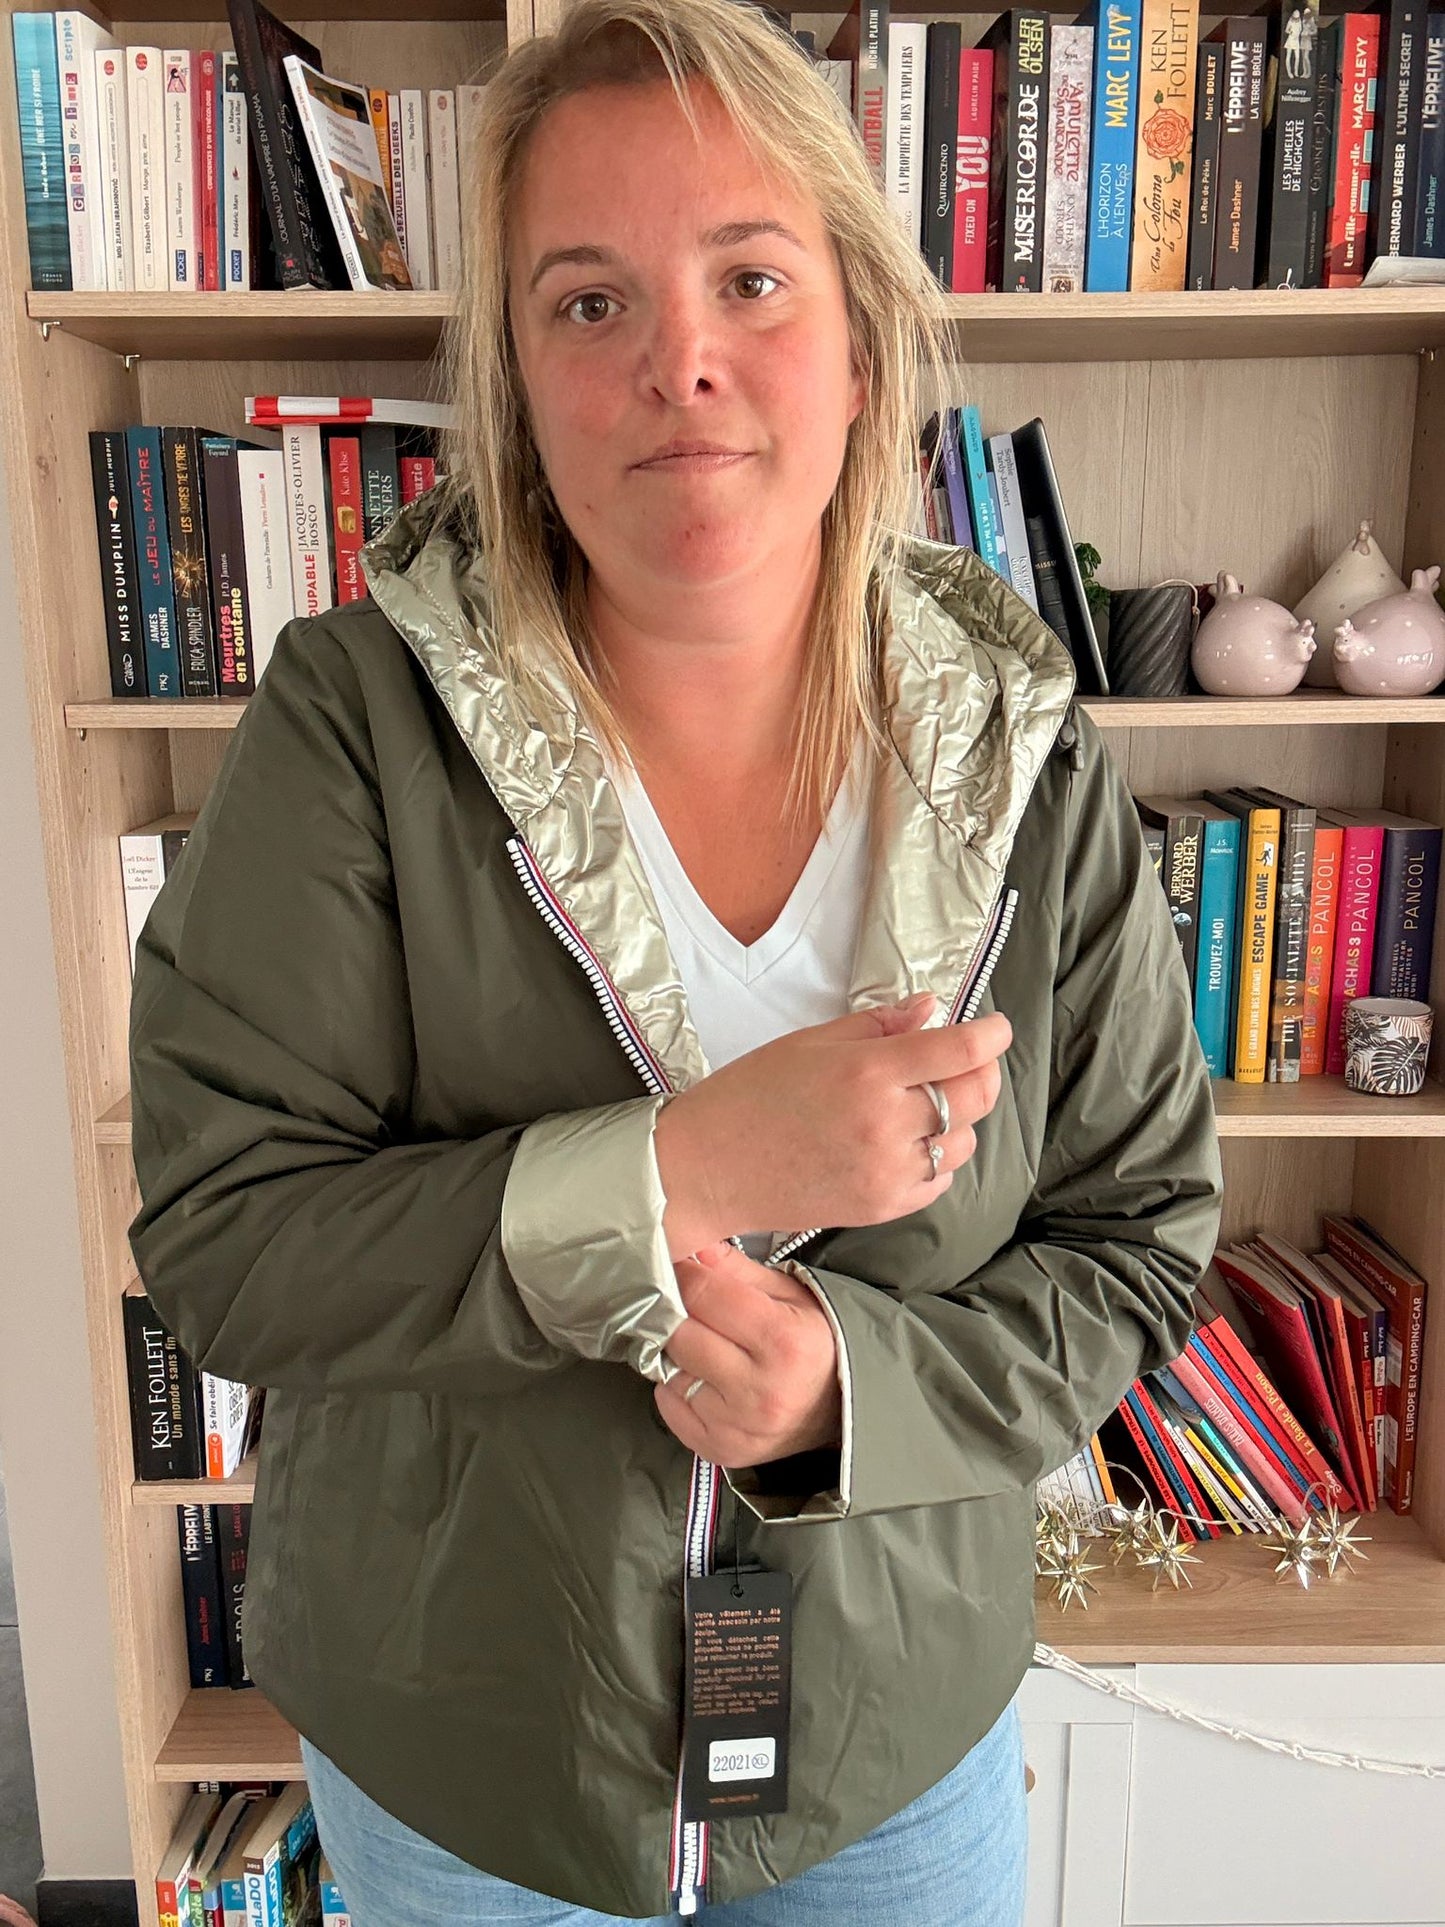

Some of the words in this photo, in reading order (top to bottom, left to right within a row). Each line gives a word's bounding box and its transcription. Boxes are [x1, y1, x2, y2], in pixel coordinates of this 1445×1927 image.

[869, 9, 879, 38] PLATINI
[1107, 9, 1132, 61] LEVY
[869, 40, 878, 69] MICHEL
[1018, 18, 1030, 66] ADLER
[1030, 19, 1044, 74] OLSEN
[1151, 29, 1167, 72] KEN
[1167, 2, 1190, 98] FOLLETT
[1250, 42, 1262, 76] BRÛLÉE
[1355, 36, 1368, 78] LEVY
[1400, 33, 1412, 76] SECRET
[901, 46, 913, 100] TEMPLIERS
[1206, 55, 1216, 94] BOULET
[1224, 41, 1248, 133] L'ÉPREUVE
[33, 99, 43, 107] SI
[971, 86, 979, 120] LAURELIN
[1105, 71, 1129, 127] MARC
[1205, 97, 1214, 120] Marc
[1251, 79, 1261, 105] TERRE
[1352, 83, 1365, 128] MARC
[1396, 79, 1409, 135] L'ULTIME
[252, 93, 265, 128] PYJAMA
[901, 104, 911, 120] DES
[1250, 107, 1260, 119] LA
[36, 128, 46, 143] UNE
[260, 130, 268, 142] EN
[392, 122, 400, 155] GEEKS
[897, 125, 910, 178] PROPHÉTIE
[1282, 120, 1294, 170] JUMELLES
[1293, 120, 1304, 174] HIGHGATE
[262, 144, 277, 179] VAMPIRE
[956, 135, 989, 193] YOU
[1202, 159, 1211, 183] Pékin
[1350, 143, 1361, 166] elle
[1393, 143, 1405, 197] WERBER
[271, 181, 280, 201] D'UN
[899, 183, 910, 193] LA
[937, 144, 950, 217] QUATTROCENTO
[1202, 186, 1209, 195] de
[1282, 174, 1292, 190] LES
[1292, 179, 1301, 191] DE
[1349, 169, 1359, 213] comme
[1425, 174, 1437, 214] Dashner
[395, 182, 404, 232] SEXUELLE
[966, 200, 976, 213] ON
[1098, 163, 1112, 238] L'HORIZON
[1143, 175, 1162, 242] Colonne
[1201, 198, 1209, 210] Roi
[1230, 179, 1242, 219] Dashner
[276, 204, 289, 244] JOURNAL
[965, 216, 976, 244] FIXED
[1055, 200, 1065, 245] STROUD
[1065, 194, 1076, 251] JONATHAN
[1113, 228, 1125, 238] À
[1163, 199, 1182, 239] Feu
[1201, 213, 1208, 223] Le
[1344, 216, 1357, 241] fille
[1389, 200, 1402, 256] BERNARD
[1423, 217, 1435, 247] James
[1230, 222, 1241, 252] James
[1344, 244, 1355, 266] Une
[105, 438, 113, 469] MURPHY
[174, 443, 187, 471] VERRE
[1005, 448, 1015, 476] Sophie
[107, 472, 115, 492] JULIE
[138, 448, 154, 512] MAÎTRE
[290, 436, 308, 547] JACQUES-OLIVIER
[340, 475, 351, 495] Kate
[368, 470, 382, 535] NNETTE
[148, 516, 156, 532] DU
[181, 517, 193, 533] LES
[308, 504, 319, 546] BOSCO
[110, 523, 127, 598] DUMPLIN
[146, 536, 159, 569] JEU
[219, 554, 229, 578] James
[152, 573, 160, 585] LE
[221, 581, 230, 597] P.D.
[305, 554, 319, 617] OUPABLE
[351, 587, 359, 600] un
[116, 605, 131, 642] MISS
[149, 613, 159, 642] JAMES
[158, 607, 170, 648] DASHNER
[187, 607, 203, 646] SPINDLER
[230, 588, 246, 656] soutane
[191, 648, 206, 671] ERICA
[219, 606, 235, 682] Meurtres
[234, 662, 247, 682] en
[1171, 842, 1184, 897] BERNARD
[1179, 834, 1198, 904] WERBER
[1255, 873, 1269, 909] GAME
[1313, 852, 1335, 934] PANCOL
[1351, 850, 1374, 932] PANCOL
[1403, 851, 1425, 929] PANCOL
[1209, 918, 1225, 991] TROUVEZ-MOI
[1252, 915, 1266, 963] ESCAPE
[1350, 937, 1361, 946] 3
[1284, 911, 1301, 1006] SOCIALITE
[1250, 1011, 1260, 1027] LIVRE
[1251, 997, 1260, 1009] DES
[1249, 1029, 1259, 1050] GRAND
[1281, 1015, 1297, 1042] THE
[165, 1336, 176, 1350] fin
[1407, 1298, 1422, 1372] CAMPING-CAR
[143, 1327, 166, 1403] FOLLETT
[167, 1354, 179, 1380] sans
[1408, 1374, 1418, 1388] EN
[169, 1384, 181, 1419] monde
[1255, 1372, 1282, 1405] Picsou
[208, 1401, 217, 1418] faire
[209, 1420, 217, 1429] Se
[1275, 1404, 1284, 1413] à
[1404, 1392, 1418, 1441] L'EUROPE
[151, 1411, 172, 1449] KEN
[171, 1425, 183, 1438] Un
[1282, 1411, 1306, 1443] Bande
[1301, 1441, 1316, 1456] La
[183, 1504, 201, 1561] L'ÉPREUV
[714, 1755, 750, 1771] 22021
[248, 1877, 263, 1927] aLaDO
